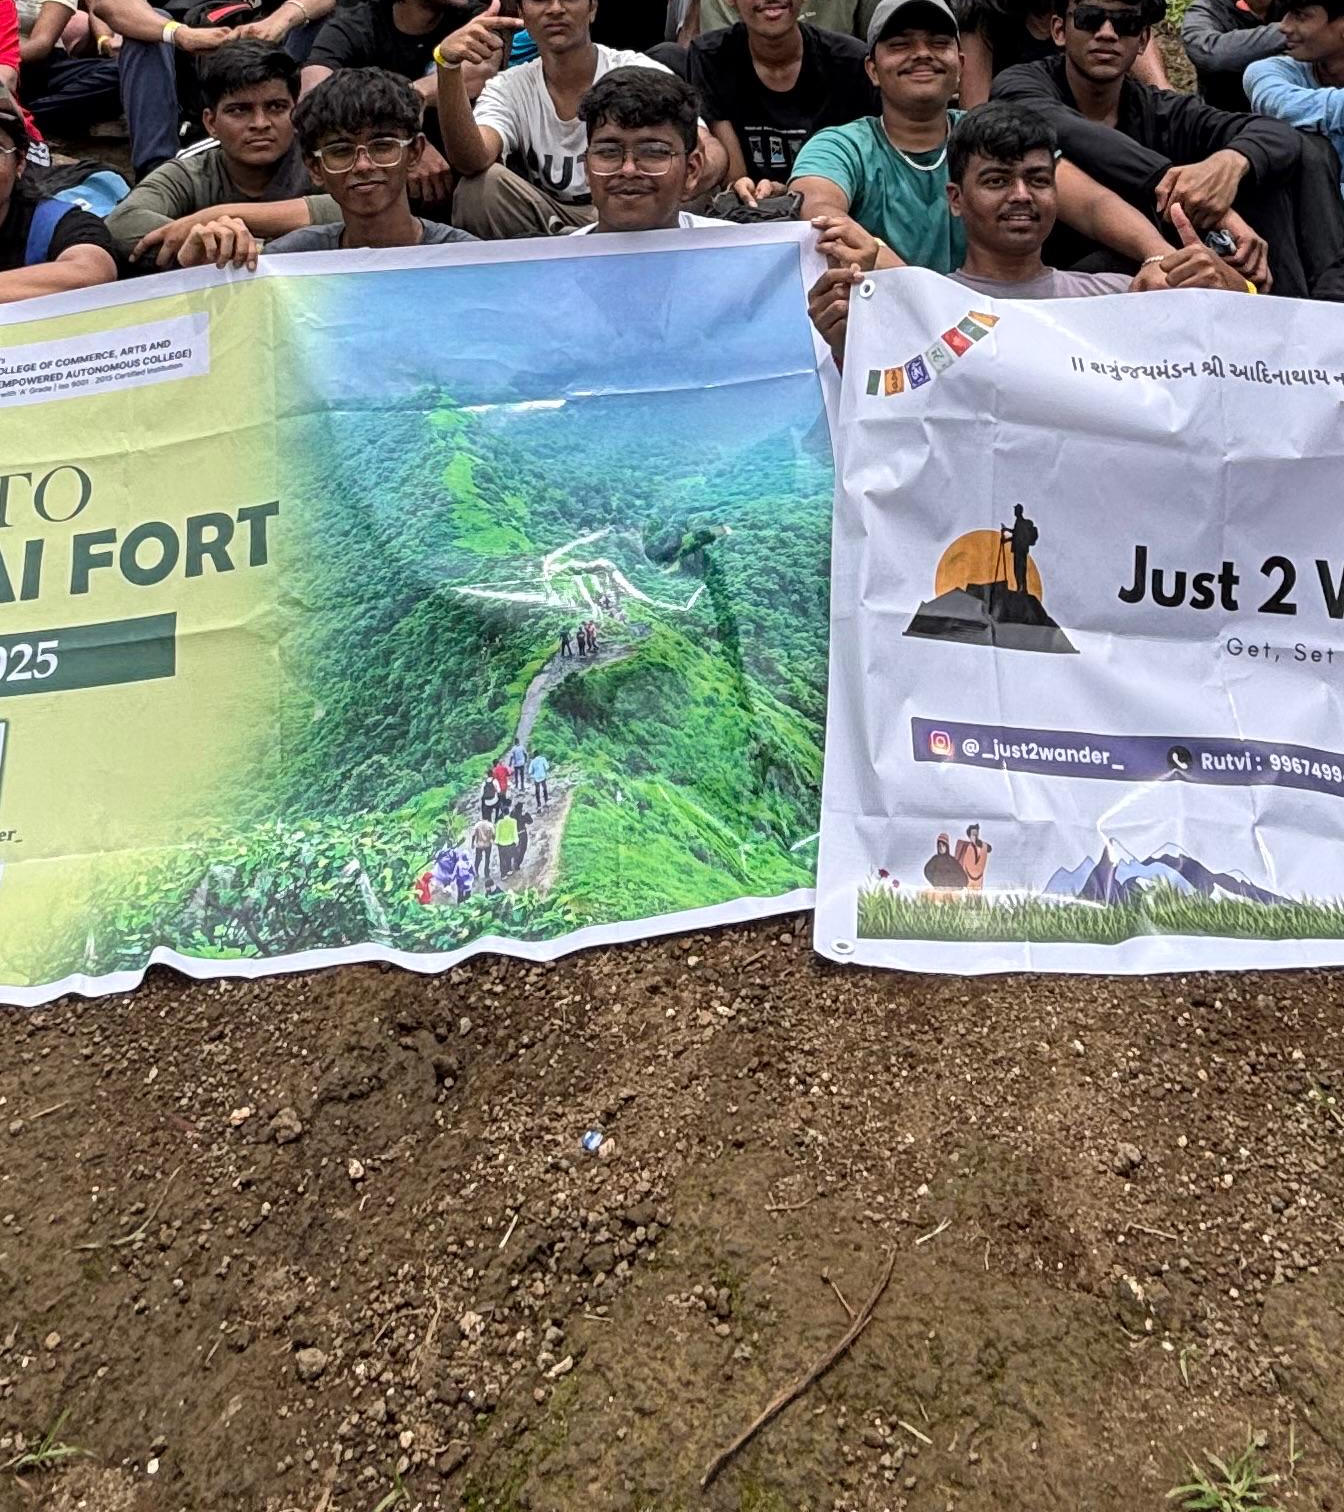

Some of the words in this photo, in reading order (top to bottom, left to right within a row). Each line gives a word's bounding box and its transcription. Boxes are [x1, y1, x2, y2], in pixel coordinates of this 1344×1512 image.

[39, 360, 53, 370] OF
[55, 350, 118, 368] COMMERCE,
[120, 344, 147, 357] ARTS
[149, 339, 172, 352] AND
[65, 359, 140, 380] AUTONOMOUS
[142, 348, 192, 366] COLLEGE)
[69, 500, 280, 595] FORT
[1117, 545, 1240, 612] Just
[1257, 555, 1298, 616] 2
[1226, 637, 1281, 663] Get,
[1293, 643, 1335, 664] Set
